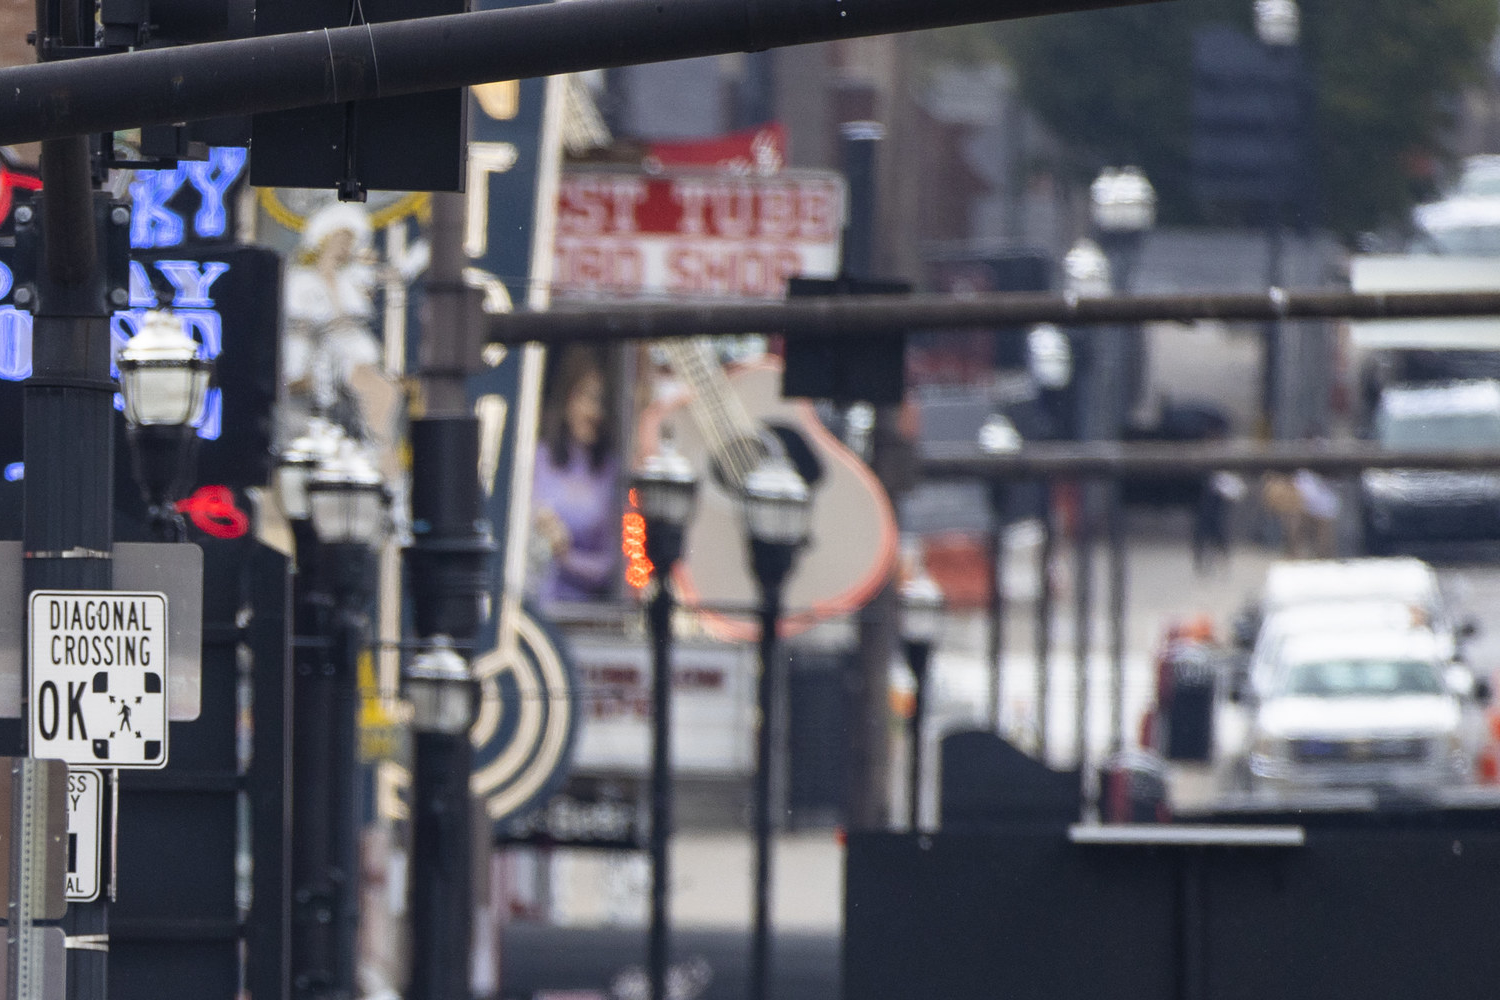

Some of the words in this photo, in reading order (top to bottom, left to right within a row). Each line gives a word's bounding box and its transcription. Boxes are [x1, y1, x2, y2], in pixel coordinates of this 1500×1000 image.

[50, 600, 151, 631] DIAGONAL
[51, 635, 150, 666] CROSSING
[38, 680, 88, 740] OK
